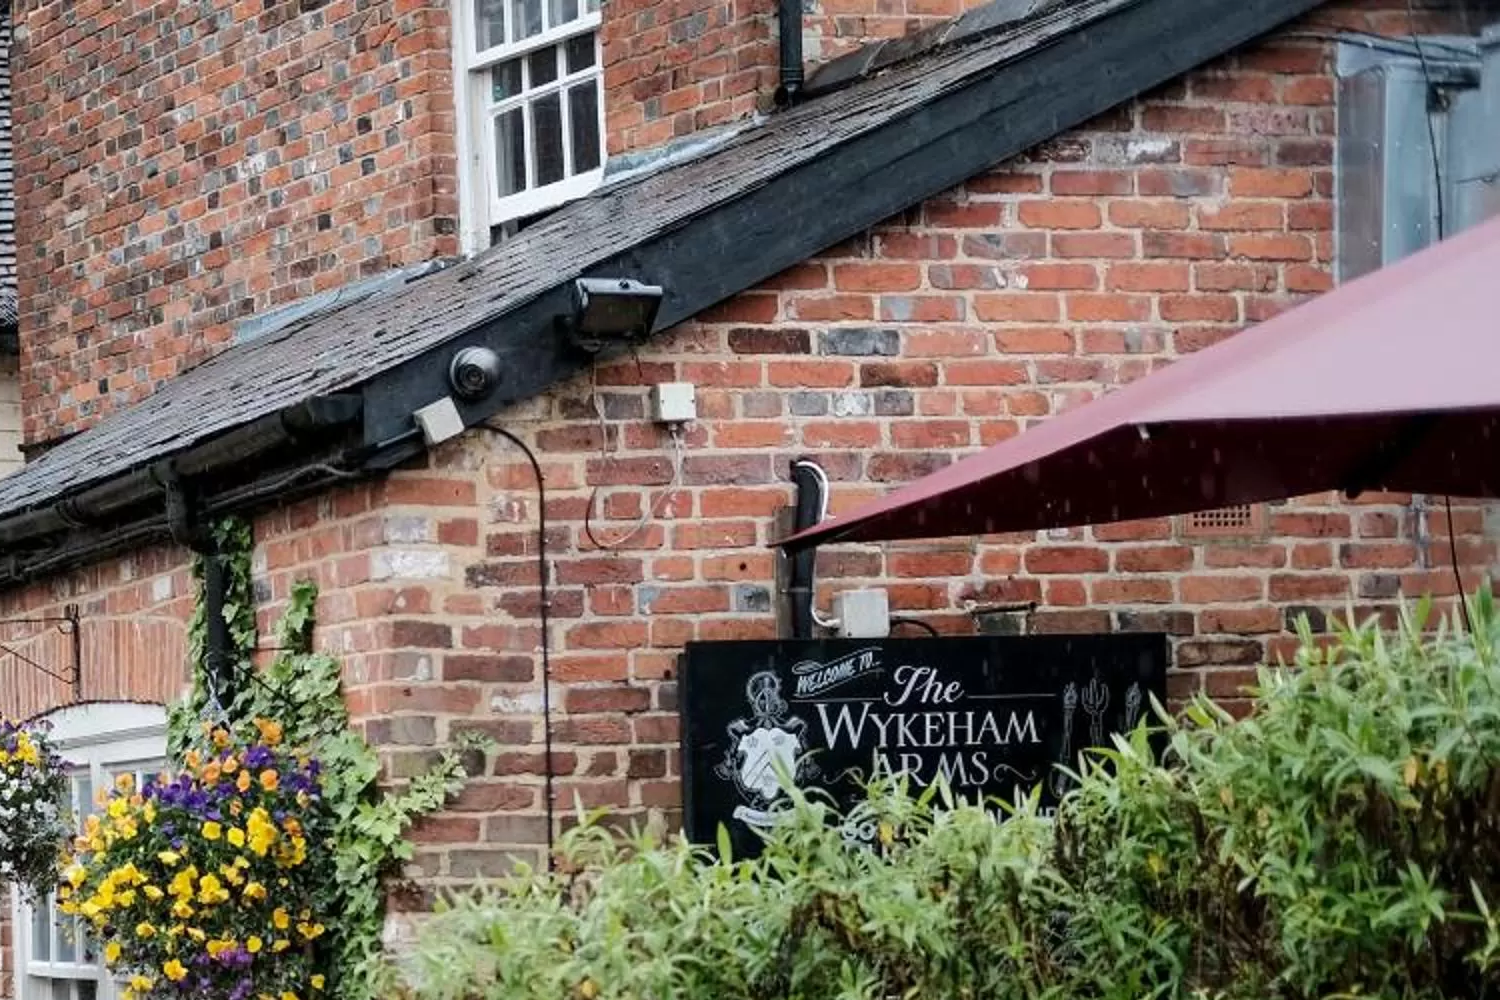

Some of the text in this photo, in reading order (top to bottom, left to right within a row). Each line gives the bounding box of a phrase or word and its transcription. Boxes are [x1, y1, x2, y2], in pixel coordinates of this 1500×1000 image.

[797, 658, 856, 693] WELCOME
[884, 665, 965, 707] The
[816, 702, 1042, 751] WYKEHAM
[868, 752, 989, 788] ARMS
